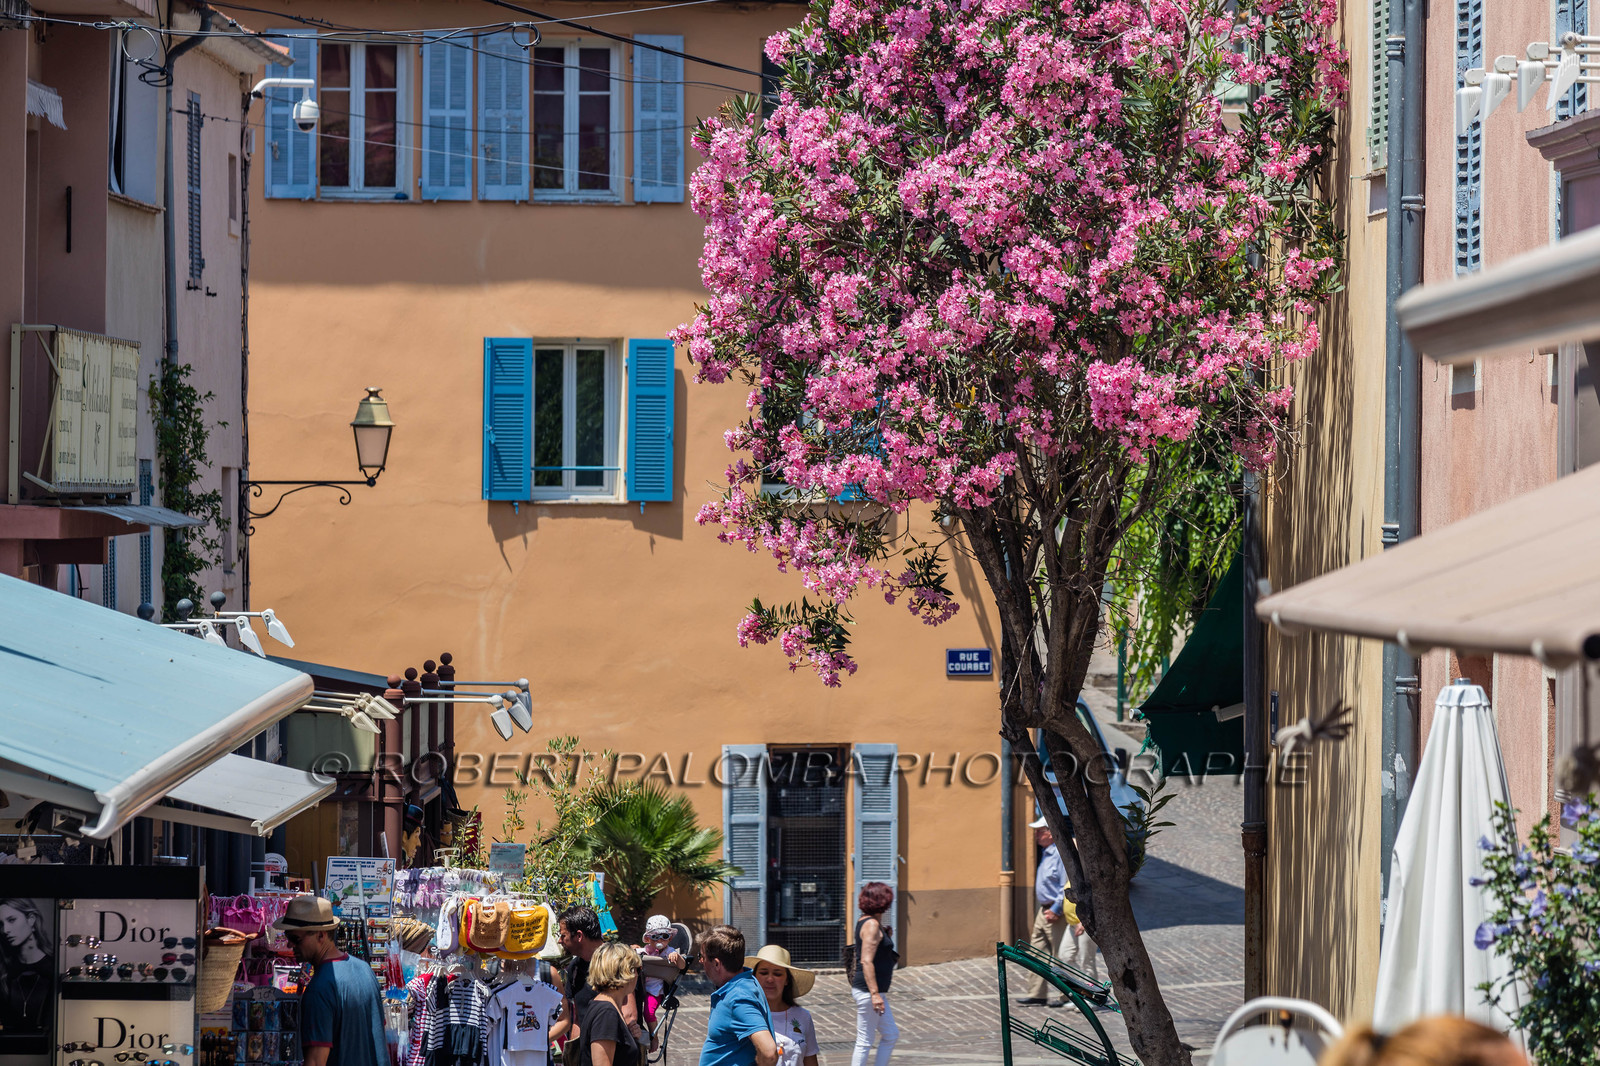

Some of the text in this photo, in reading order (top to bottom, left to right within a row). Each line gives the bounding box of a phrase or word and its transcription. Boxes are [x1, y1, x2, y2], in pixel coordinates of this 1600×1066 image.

[948, 662, 990, 671] COURBET
[959, 652, 980, 661] RUE
[94, 911, 171, 943] Dior
[93, 1017, 169, 1049] Dior
